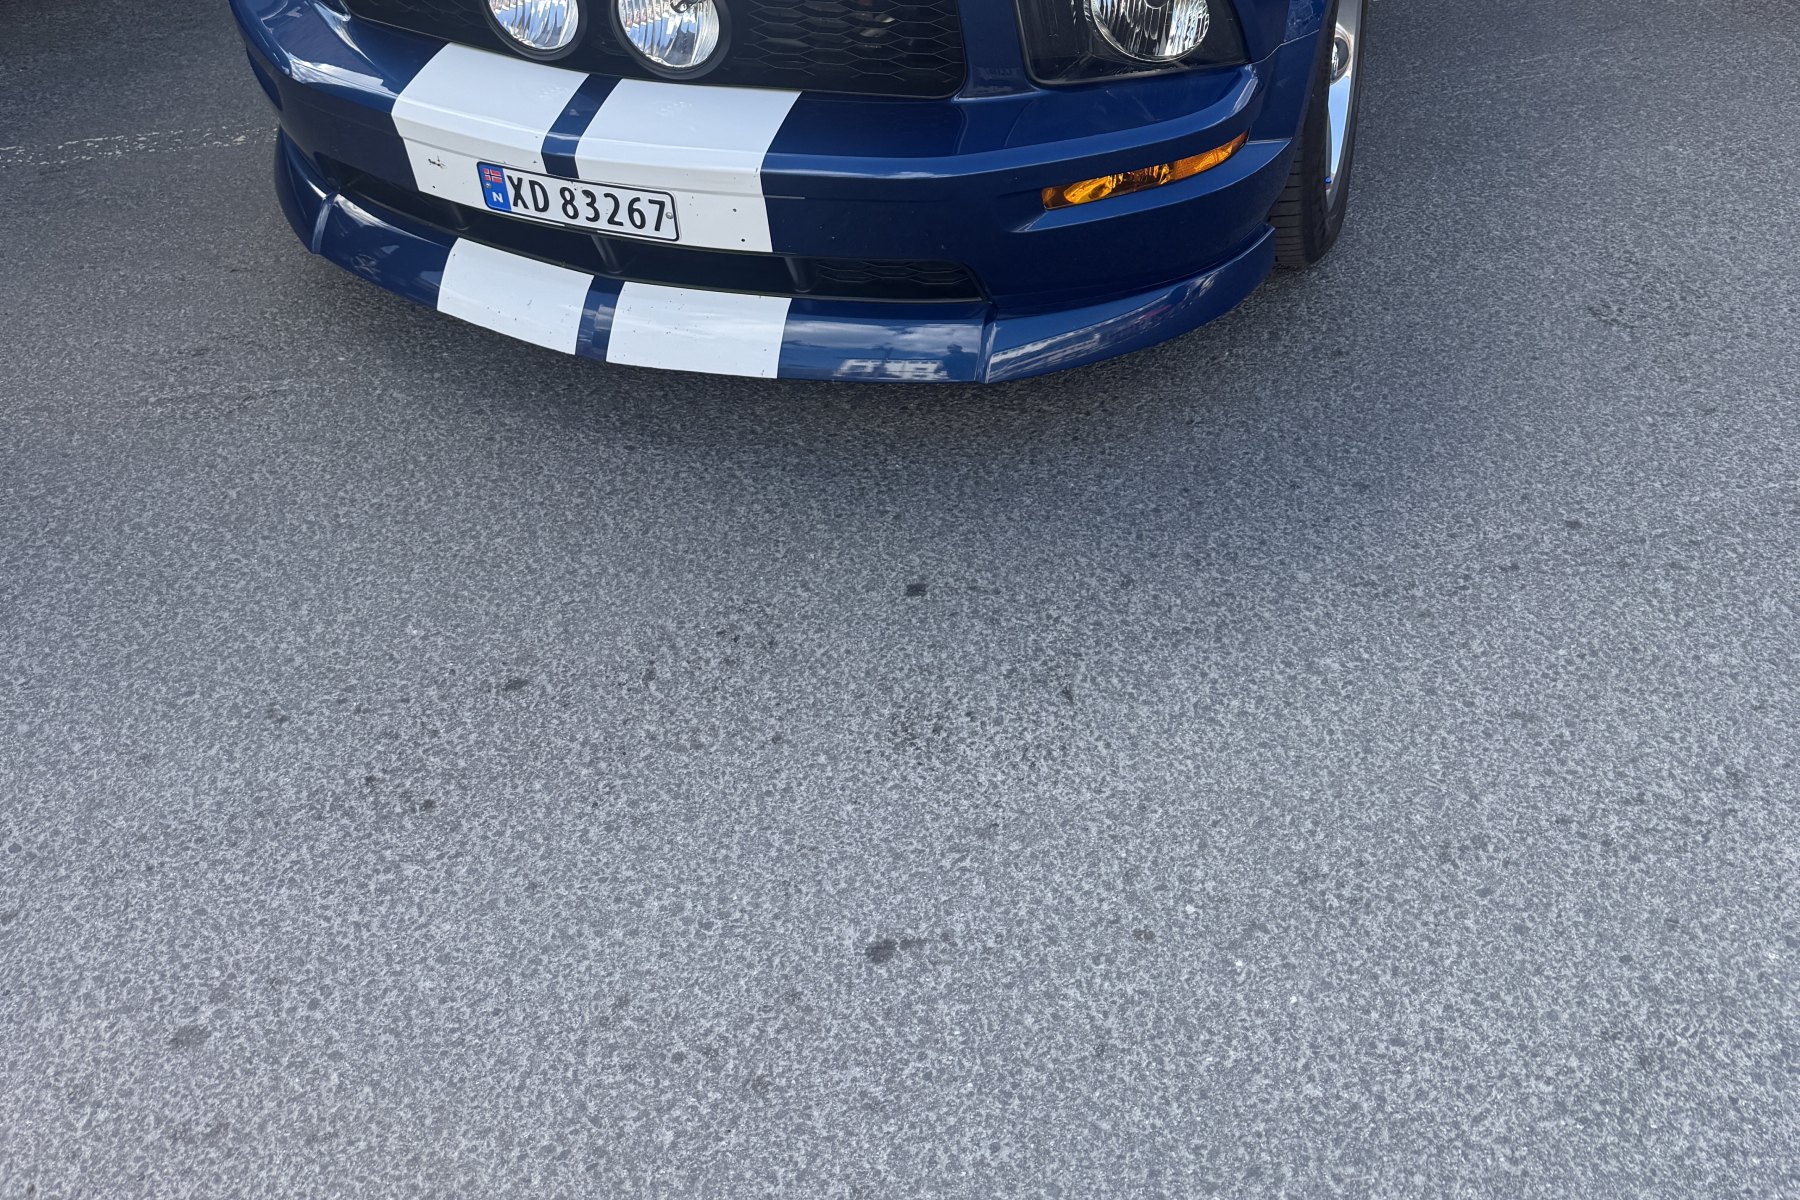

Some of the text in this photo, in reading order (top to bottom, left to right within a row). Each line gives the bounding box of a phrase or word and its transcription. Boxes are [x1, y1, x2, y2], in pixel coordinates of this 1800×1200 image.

[492, 191, 504, 203] N
[507, 174, 666, 232] XD 83267
